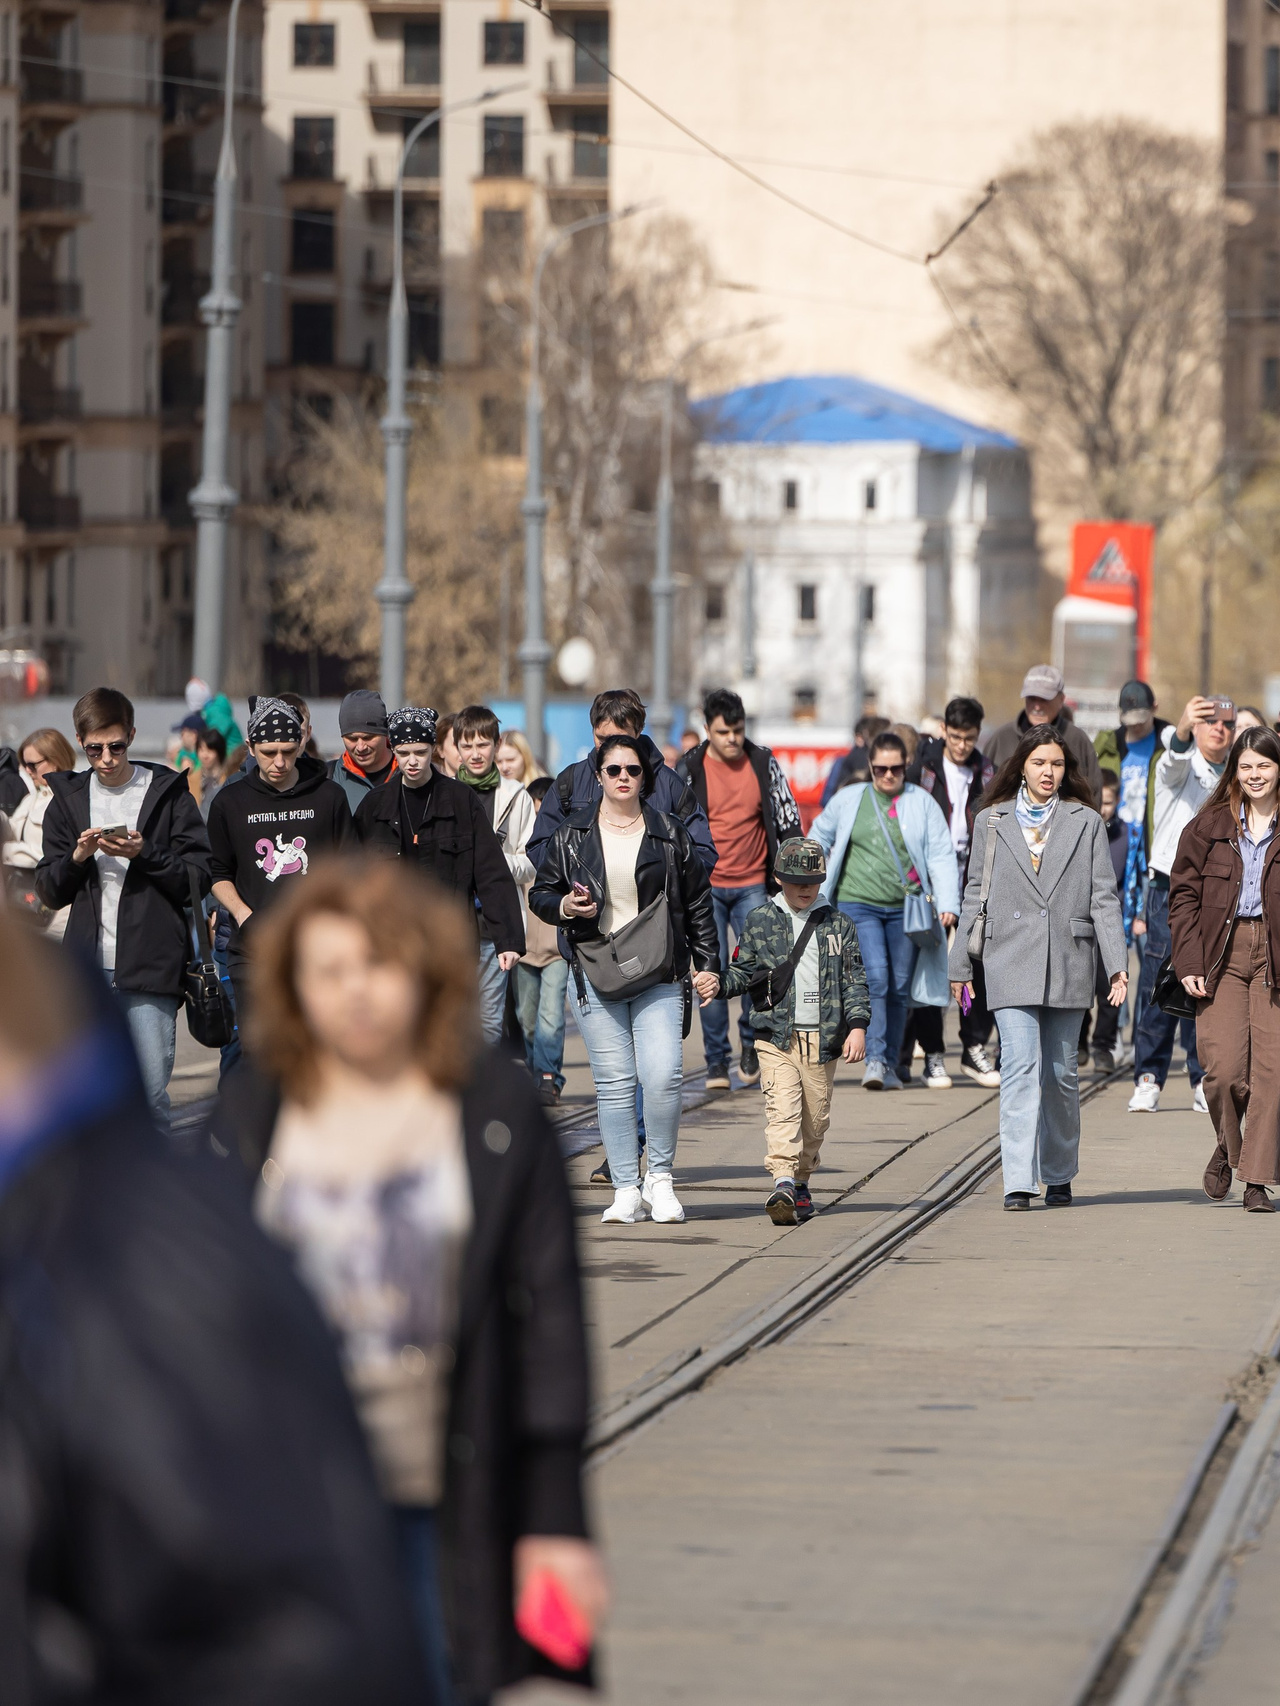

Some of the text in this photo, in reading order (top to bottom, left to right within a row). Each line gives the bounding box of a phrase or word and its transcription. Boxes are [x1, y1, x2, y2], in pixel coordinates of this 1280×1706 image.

[247, 809, 315, 824] МЕЧТАТЬ НЕ ВРЕДНО
[826, 933, 842, 956] N
